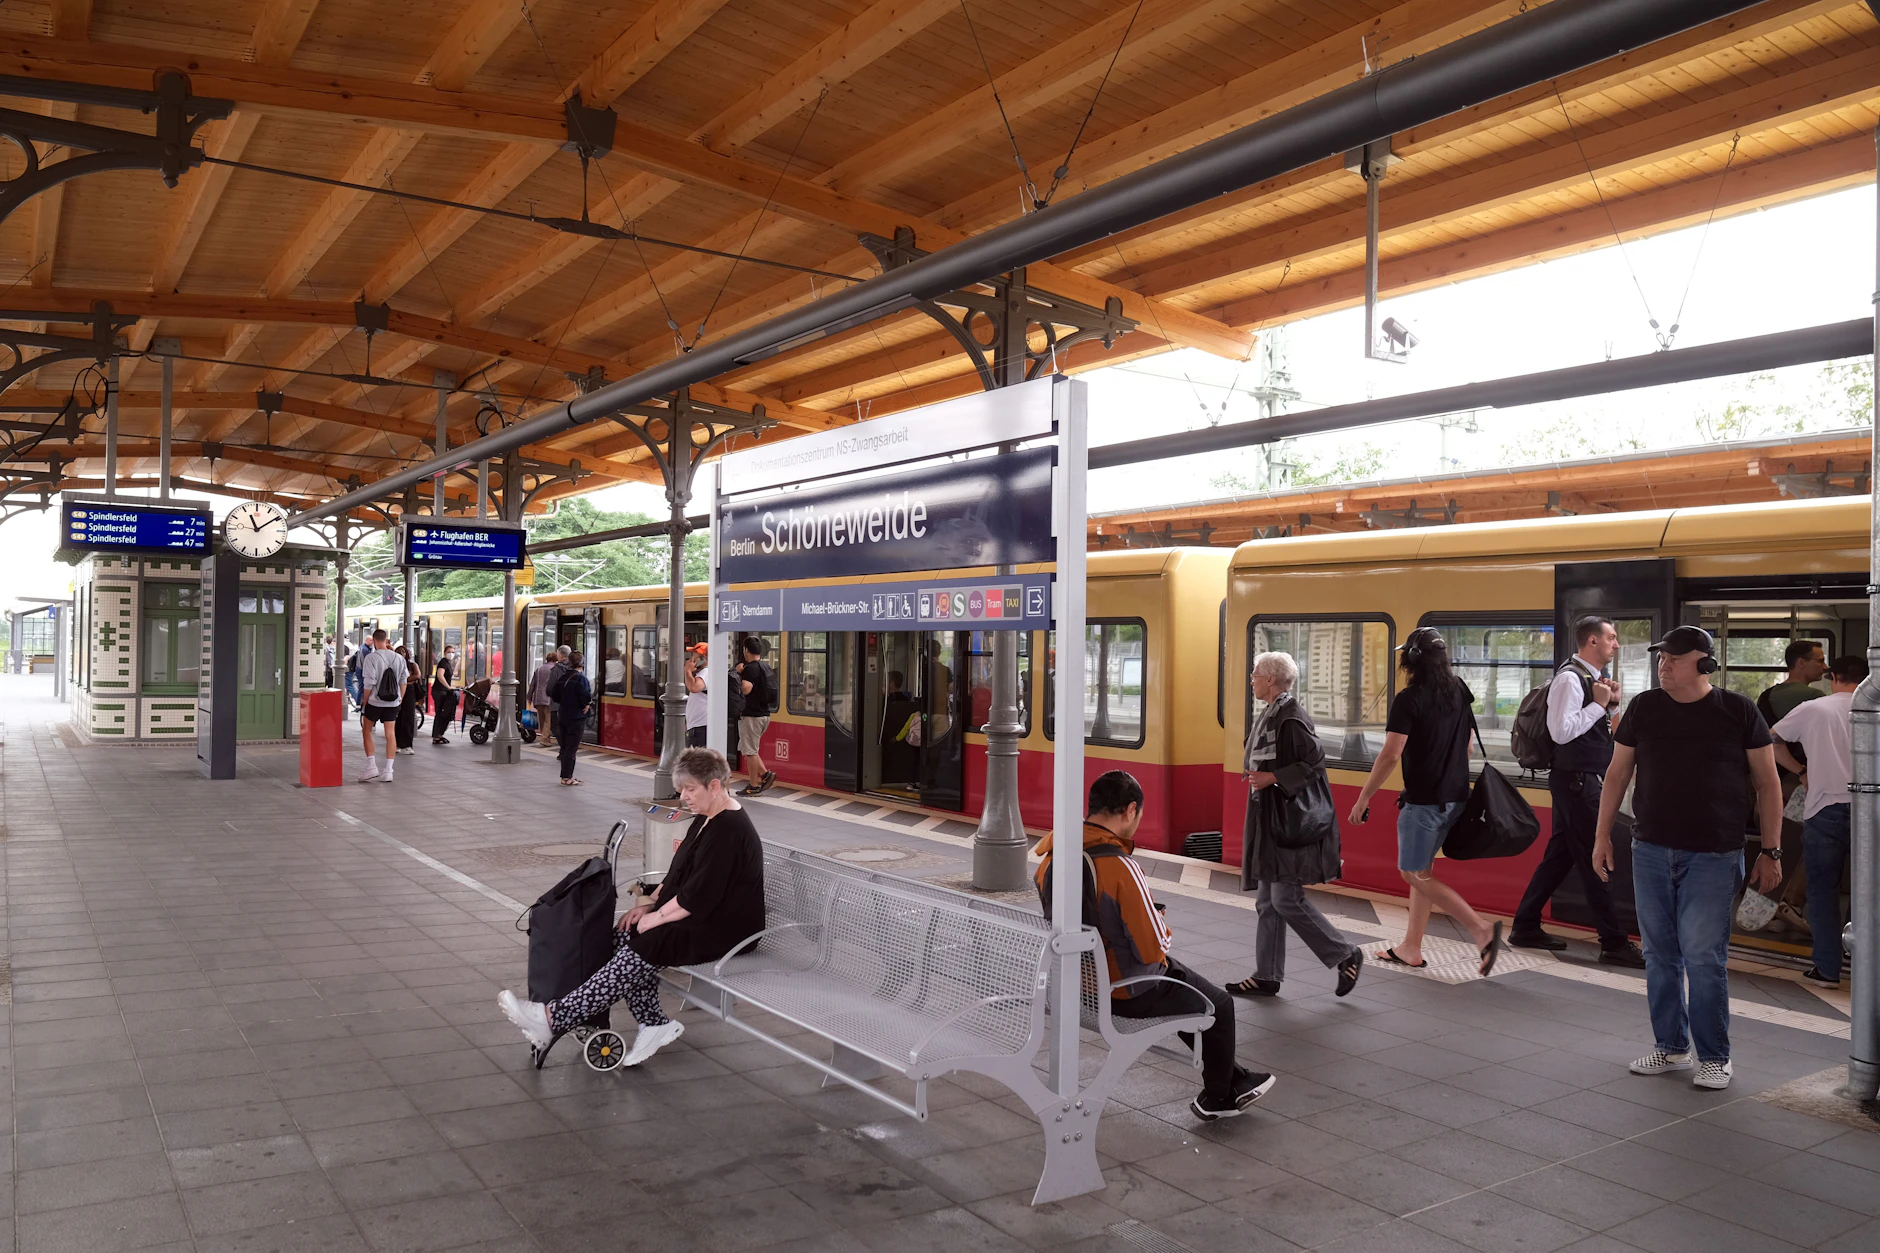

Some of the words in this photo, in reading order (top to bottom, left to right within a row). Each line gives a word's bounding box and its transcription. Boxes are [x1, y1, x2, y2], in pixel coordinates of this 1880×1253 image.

[750, 445, 834, 473] Dokumentationszentrum
[836, 427, 909, 456] NS-Zwangsarbeit
[88, 511, 138, 523] Spindlersfeld
[190, 517, 196, 525] 7
[730, 539, 756, 557] Berlin
[760, 491, 928, 554] Schöneweide
[88, 522, 137, 533] Spindlersfeld
[185, 528, 195, 536] 27
[440, 530, 474, 542] Flughafen
[475, 532, 489, 541] BER
[88, 533, 137, 544] Spindlersfeld
[184, 538, 195, 547] 47
[742, 604, 773, 616] Sterndamm
[801, 600, 870, 615] Michael-Brückner-Str.
[953, 593, 965, 617] S
[970, 600, 982, 609] BUS
[986, 598, 1001, 609] Tram
[1005, 598, 1019, 608] TAXI
[777, 741, 789, 758] DB
